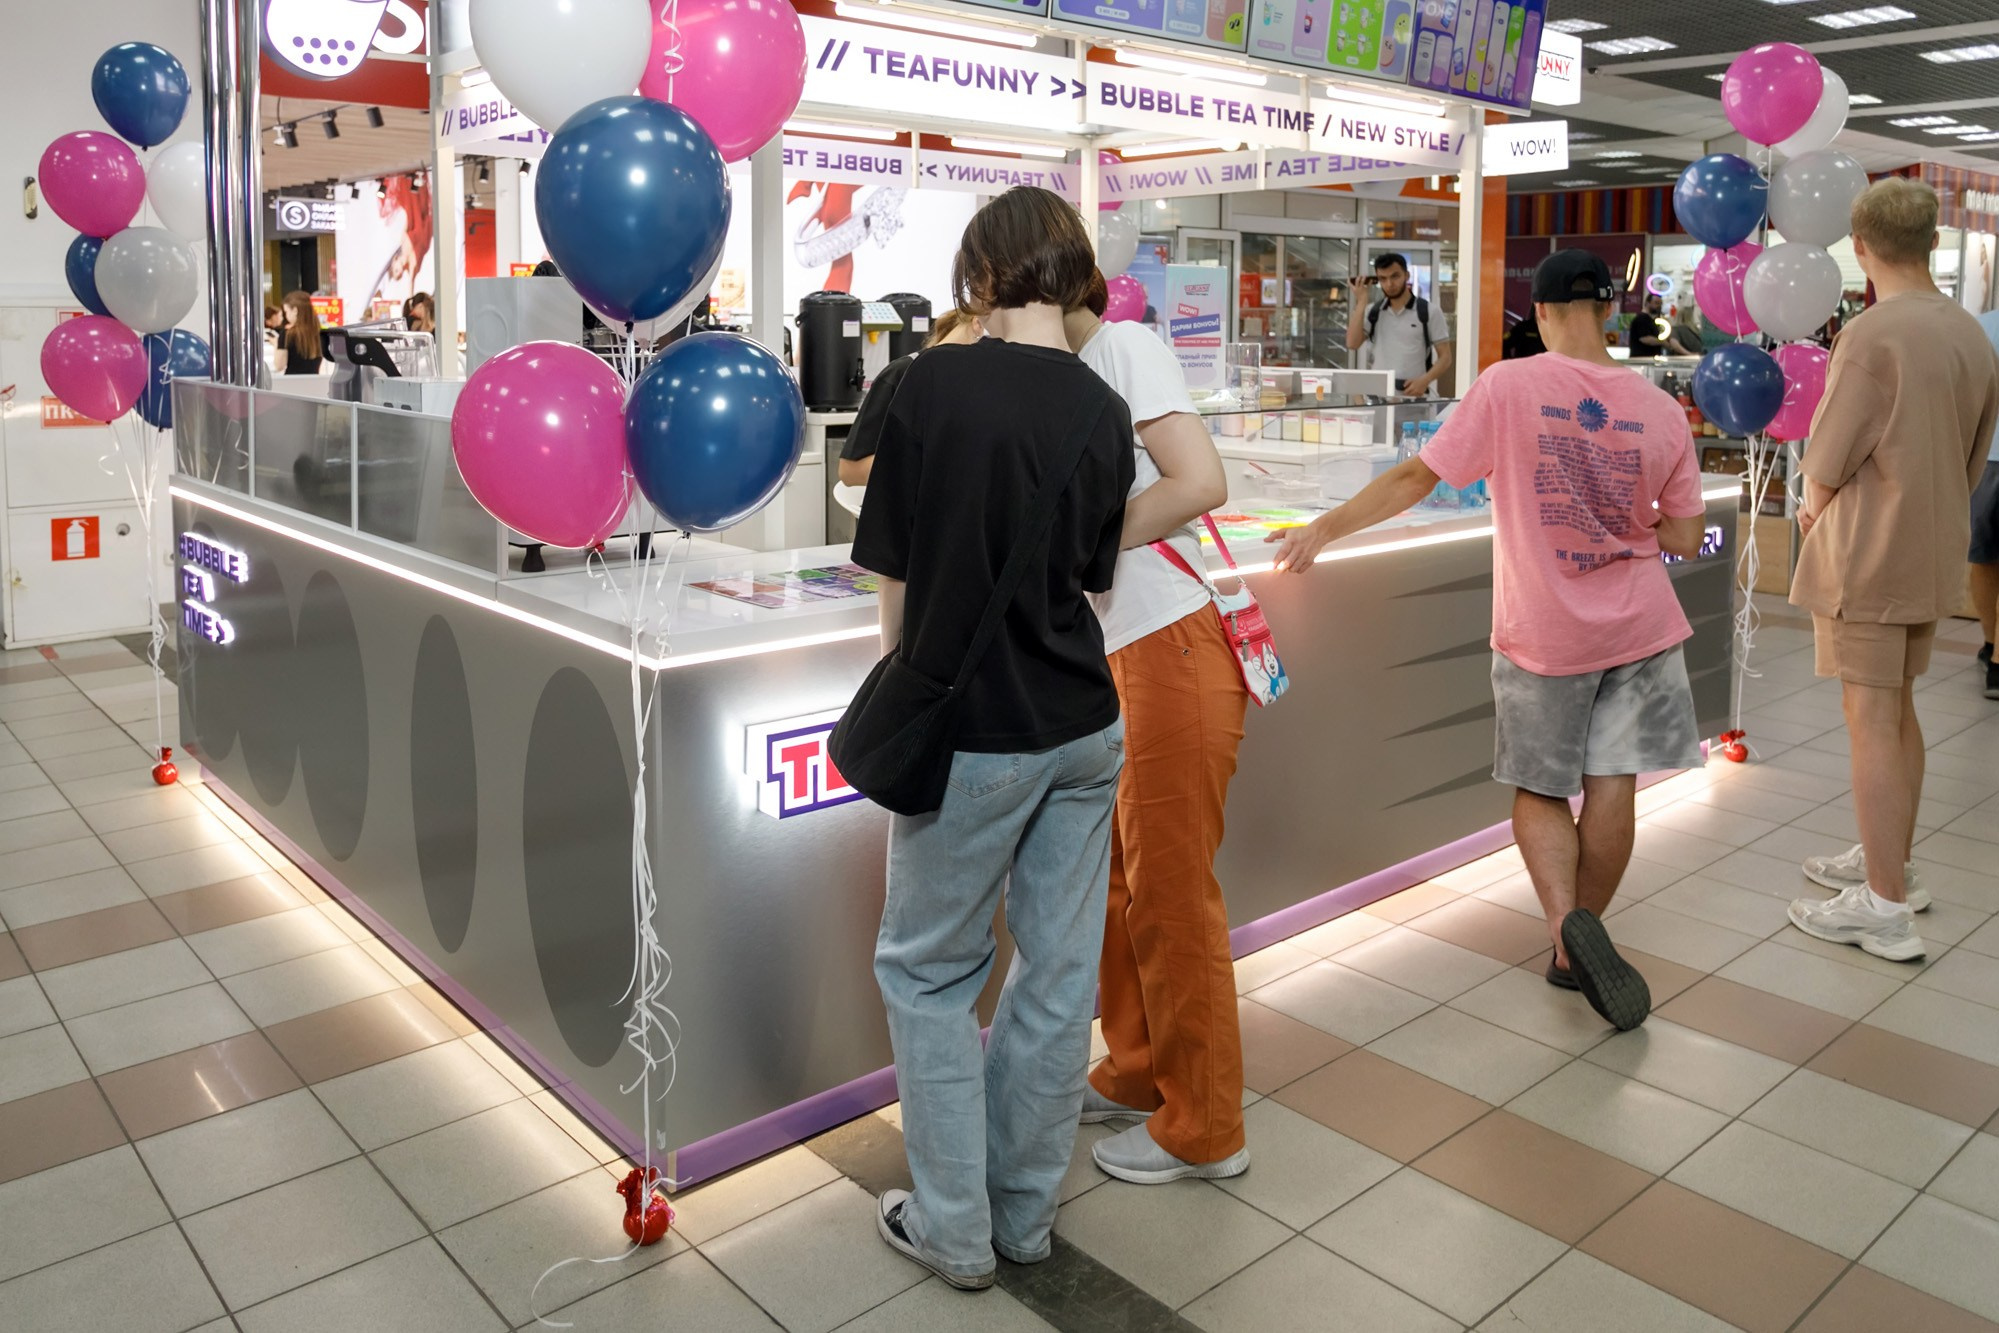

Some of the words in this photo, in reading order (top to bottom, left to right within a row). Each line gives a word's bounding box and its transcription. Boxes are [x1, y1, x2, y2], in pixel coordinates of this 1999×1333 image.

[1540, 54, 1571, 76] UNNY
[863, 46, 1039, 95] TEAFUNNY
[1101, 81, 1204, 118] BUBBLE
[1212, 98, 1257, 125] TEA
[1263, 106, 1315, 132] TIME
[1341, 118, 1387, 143] NEW
[1394, 126, 1450, 152] STYLE
[1510, 138, 1557, 157] WOW!
[1171, 323, 1192, 332] ДАРИМ
[1541, 405, 1571, 421] SOUNDS
[1556, 549, 1567, 560] THE
[1572, 552, 1595, 563] BREEZE
[1579, 563, 1586, 571] BY
